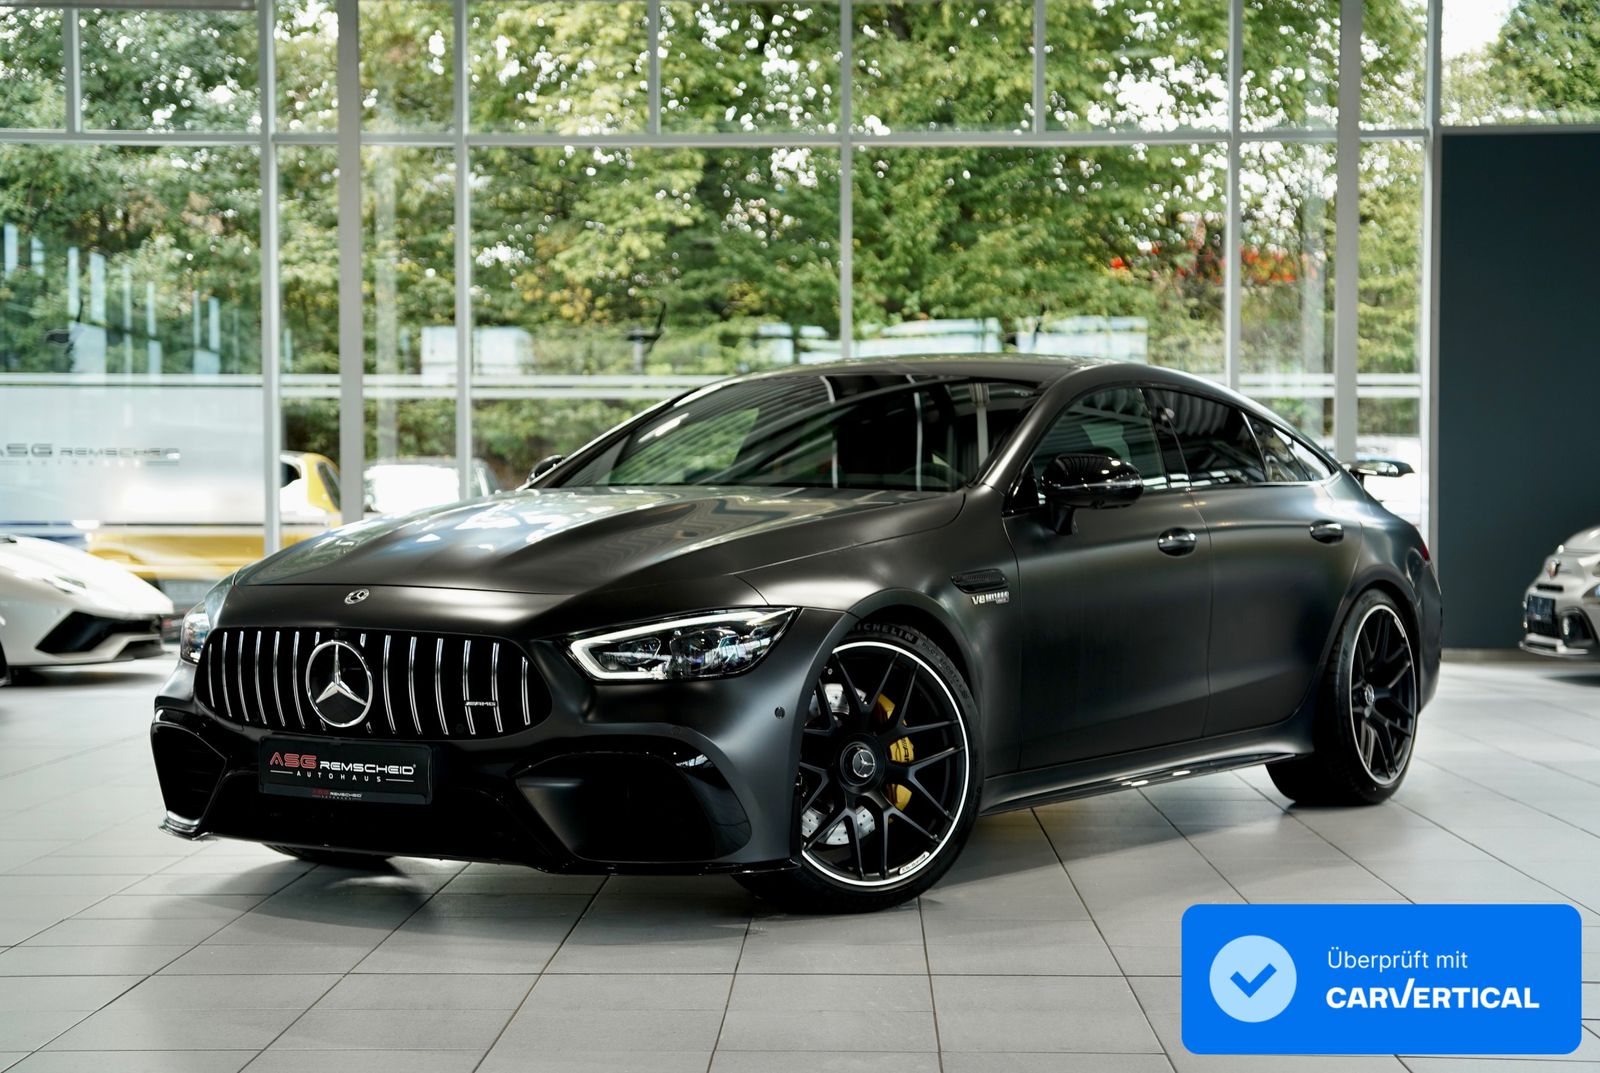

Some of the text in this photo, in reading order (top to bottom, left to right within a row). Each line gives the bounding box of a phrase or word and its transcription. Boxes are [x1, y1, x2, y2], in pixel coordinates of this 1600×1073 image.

[971, 594, 986, 605] V8
[856, 622, 914, 642] ICHELIN
[269, 751, 317, 769] ASG
[296, 770, 382, 783] AUTOHAUS
